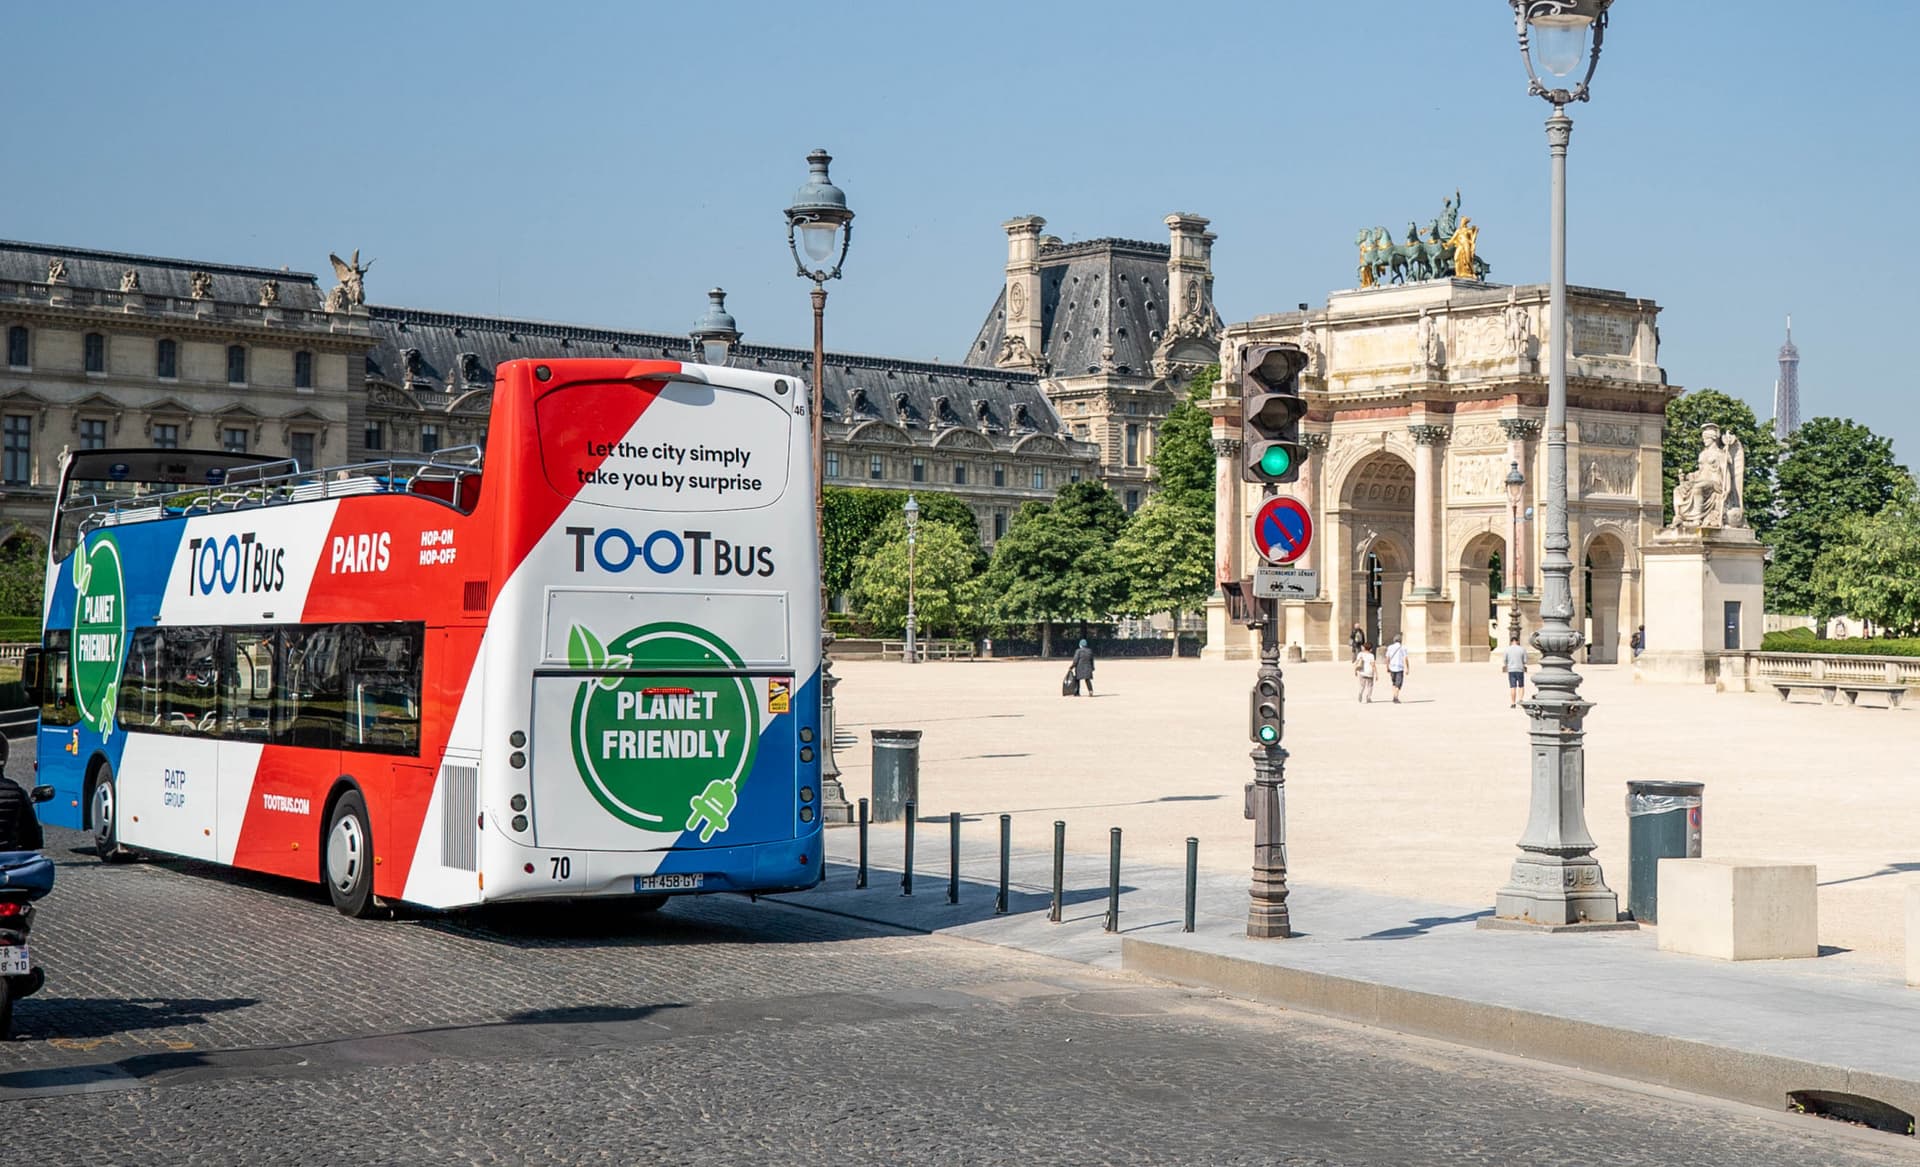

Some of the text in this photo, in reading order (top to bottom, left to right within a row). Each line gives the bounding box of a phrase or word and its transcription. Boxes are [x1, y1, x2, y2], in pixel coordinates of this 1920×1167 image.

[794, 405, 805, 416] 46
[587, 441, 751, 467] Let the city simply
[577, 468, 762, 494] take you by surprise
[421, 529, 454, 546] HOP-ON
[331, 531, 391, 574] PARIS
[419, 548, 457, 565] HOP-OFF
[85, 595, 115, 624] PLANET
[79, 634, 117, 662] FRIENDLY
[617, 690, 718, 720] PLANET
[602, 730, 730, 759] FRIENDLY
[164, 769, 185, 790] RATP
[164, 792, 185, 808] GROUP
[263, 794, 310, 815] TOOTBUS.COM
[550, 856, 570, 880] 70
